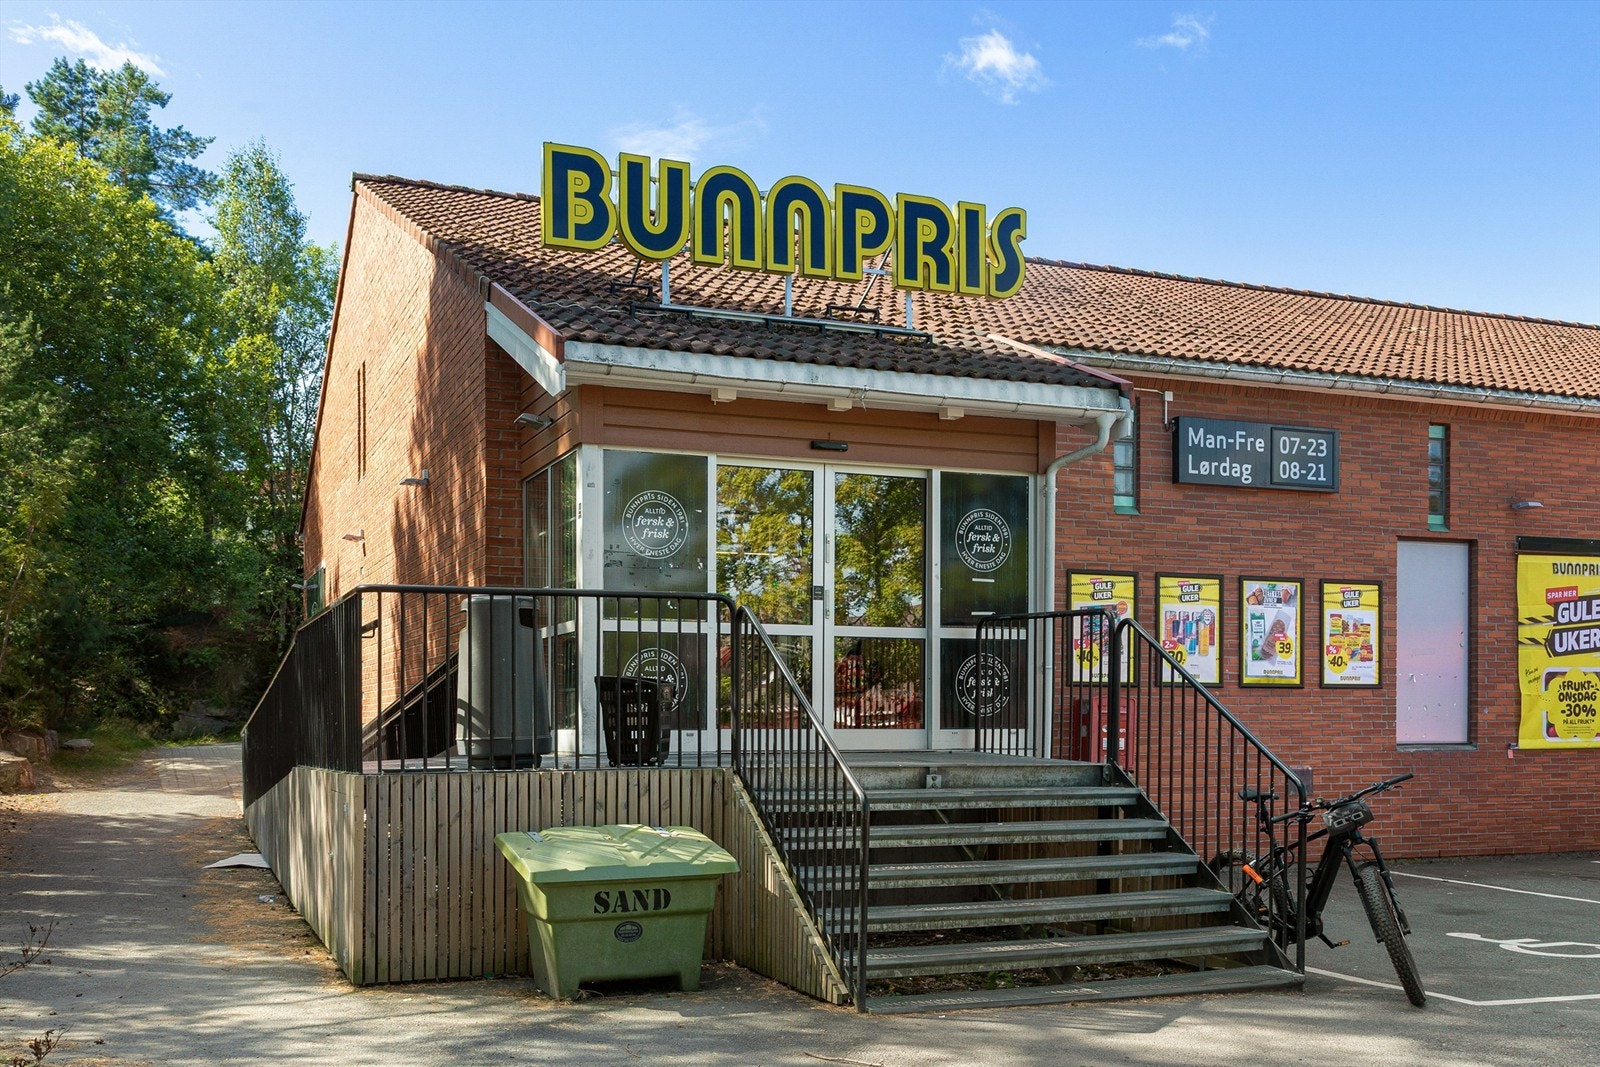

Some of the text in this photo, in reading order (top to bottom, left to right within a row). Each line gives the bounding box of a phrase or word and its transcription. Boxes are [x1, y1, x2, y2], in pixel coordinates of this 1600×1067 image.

[541, 141, 1027, 298] BUNNPRIS
[1188, 427, 1326, 457] Man-Fre 07-23
[1188, 455, 1326, 484] Lørdag 08-21
[626, 493, 685, 523] BUNNPRIS SIDEN 1981
[635, 516, 674, 528] fersk &
[959, 512, 983, 534] BUNNPRIS
[985, 512, 1002, 524] SIDEN
[641, 528, 669, 539] frisk
[967, 532, 1000, 542] fersk &
[629, 536, 644, 552] HVER
[670, 538, 681, 550] DAG
[972, 543, 995, 554] frisk
[961, 551, 974, 566] HVER
[996, 552, 1006, 564] DAG
[1557, 600, 1600, 623] GULE
[1554, 628, 1600, 652] UKER
[1562, 681, 1594, 691] FRUKT-
[1558, 692, 1597, 703] ONSDAG
[1561, 704, 1596, 717] -30%
[594, 888, 671, 914] SAND
